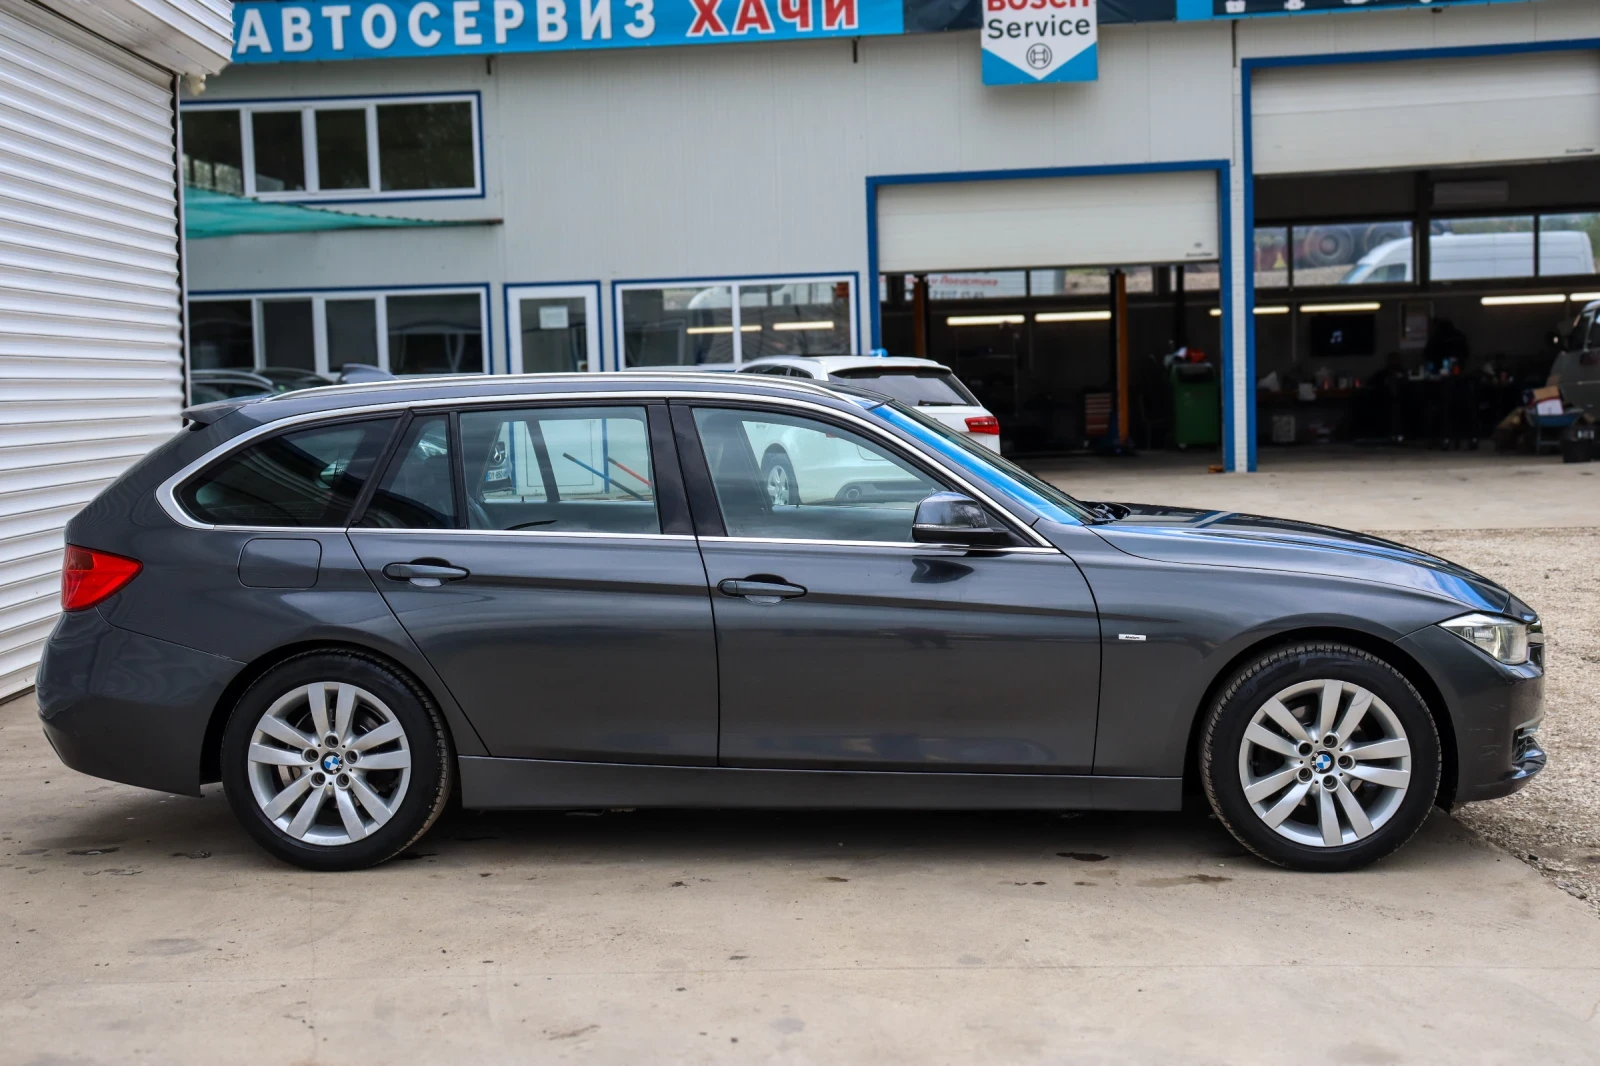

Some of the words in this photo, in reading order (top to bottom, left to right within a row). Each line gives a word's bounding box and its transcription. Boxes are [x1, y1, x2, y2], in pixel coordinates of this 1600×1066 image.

[236, 0, 656, 54] АВТОСЕРВИЗ
[686, 0, 859, 37] ХАЧИ
[987, 14, 1091, 39] Service
